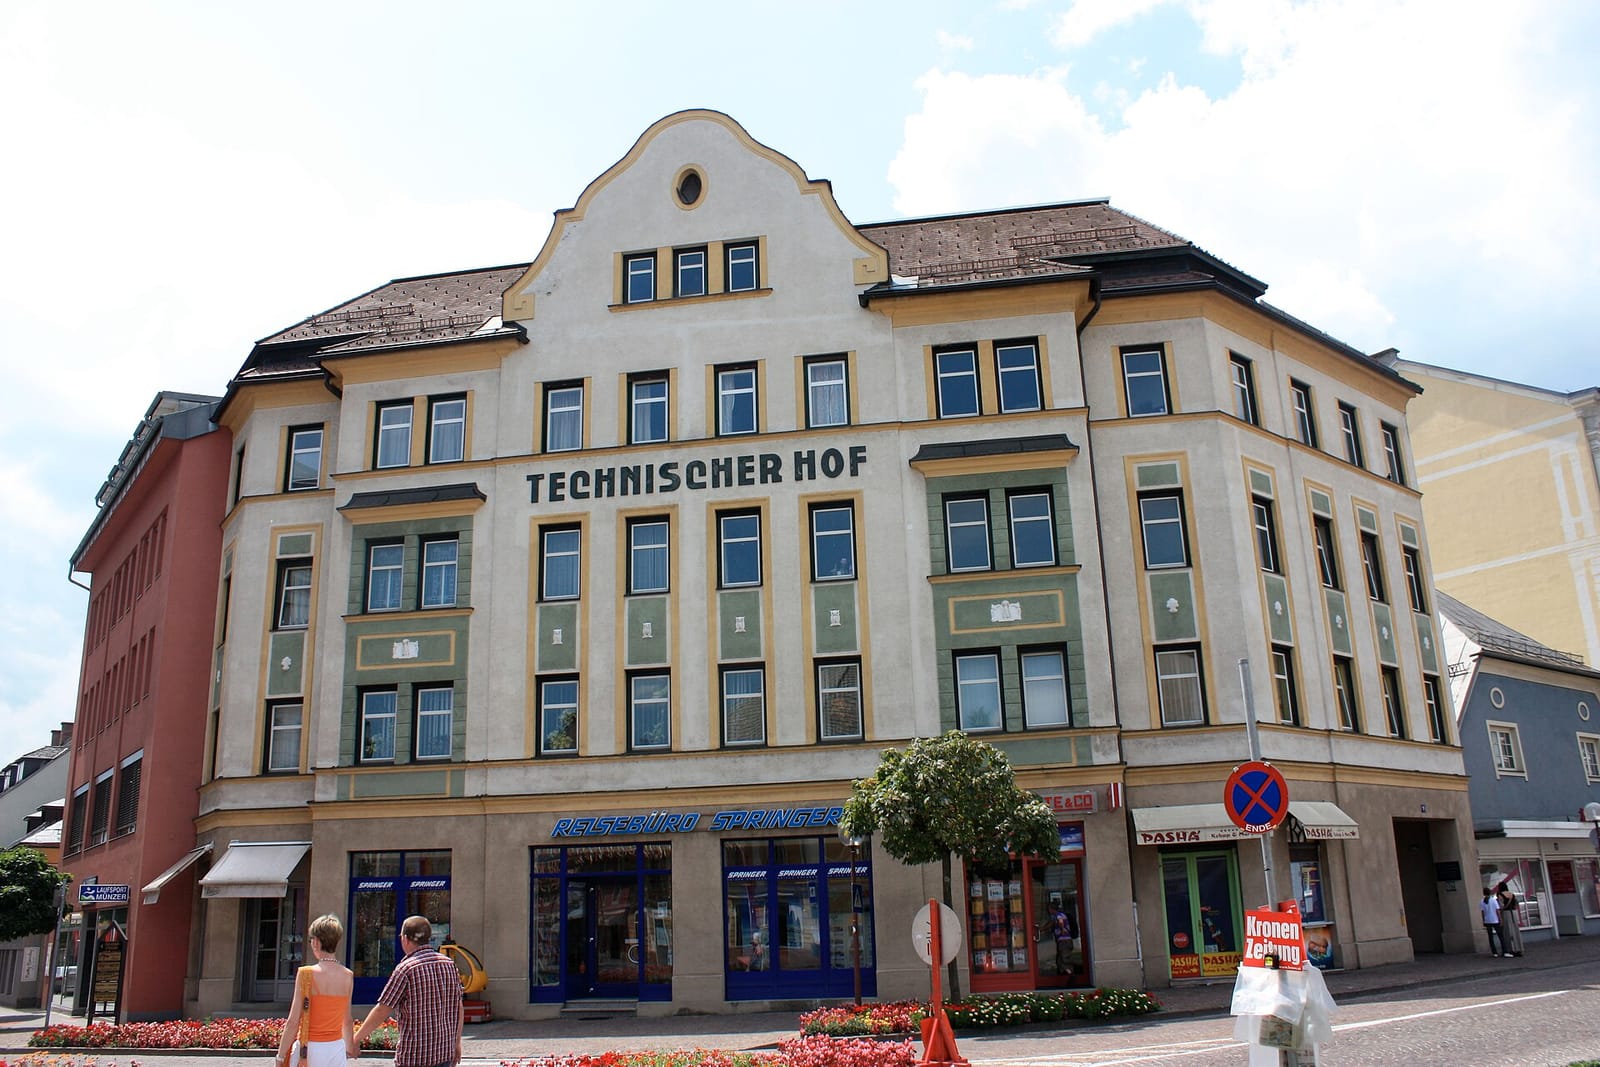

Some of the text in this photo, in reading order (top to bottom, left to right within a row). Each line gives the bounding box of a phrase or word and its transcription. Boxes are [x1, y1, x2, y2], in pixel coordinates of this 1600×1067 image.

[526, 445, 867, 504] TECHNISCHER HOF
[551, 806, 845, 838] REISEBÜRO SPRINGER
[1245, 822, 1273, 833] ENDE
[728, 870, 767, 879] SPRINGER
[827, 866, 868, 874] SPRINER
[96, 886, 127, 894] LAUFSPORT
[1246, 915, 1300, 940] Kronen
